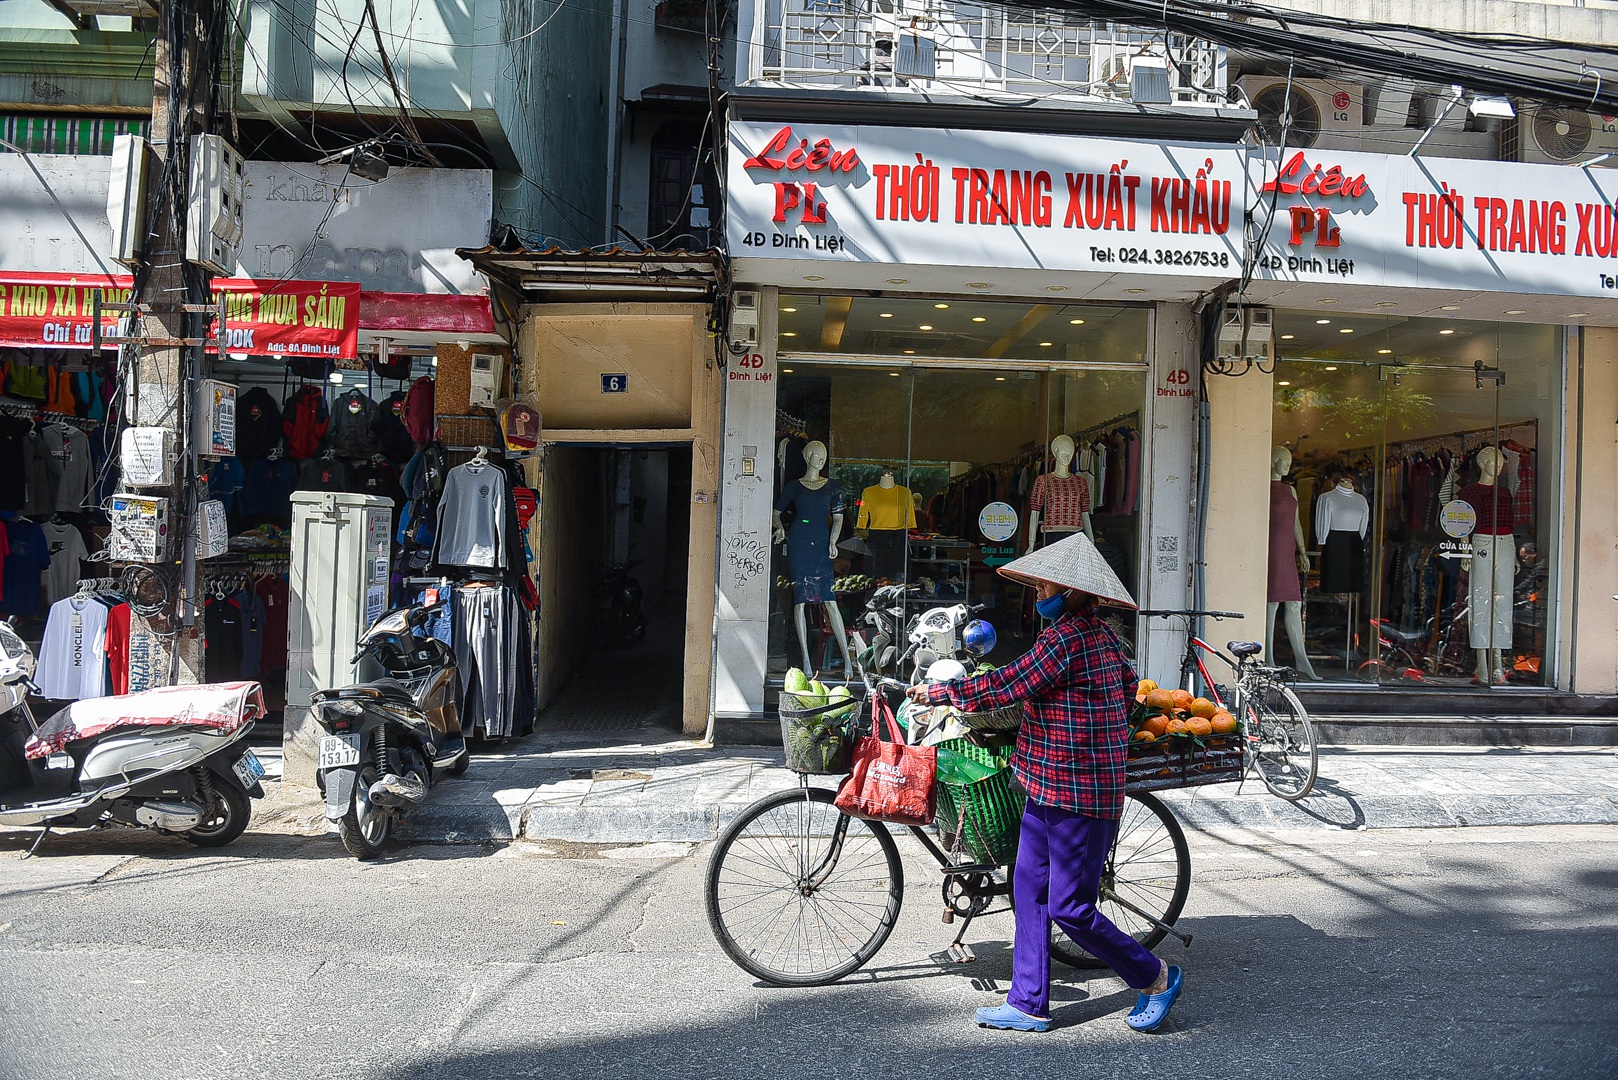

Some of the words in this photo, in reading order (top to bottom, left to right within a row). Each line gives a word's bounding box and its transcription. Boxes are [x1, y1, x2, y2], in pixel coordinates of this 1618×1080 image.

[1334, 112, 1348, 121] LG
[1602, 124, 1616, 132] LG
[743, 126, 861, 172] Liên
[1258, 151, 1369, 198] Liên
[772, 182, 828, 223] PL
[873, 153, 940, 223] THỜI
[952, 167, 1053, 228] TRANG
[1064, 160, 1141, 231] XUẤT
[1151, 158, 1231, 235] KHẨU
[1288, 206, 1341, 247] PL
[1402, 182, 1464, 249] THỜI
[1474, 197, 1567, 256] TRANG
[743, 232, 766, 247] 4Đ
[772, 233, 809, 249] Đinh
[816, 235, 845, 254] Liệt
[1090, 247, 1115, 262] Tel:
[1119, 247, 1229, 268] 024.38267538
[1260, 256, 1283, 270] 4Đ
[1288, 256, 1323, 273] Đinh
[1328, 258, 1356, 277] Liệt
[11, 286, 48, 317] KHO
[52, 278, 77, 317] XẢ
[257, 293, 298, 326] MUA
[303, 283, 346, 330] SẮM
[43, 321, 72, 343] Chỉ
[75, 323, 93, 343] từ
[267, 342, 287, 353] Add:
[288, 343, 300, 353] 8A
[302, 343, 321, 354] Đinh
[323, 344, 341, 356] Liệt
[740, 354, 764, 368] 4Đ
[610, 377, 619, 390] 6
[729, 371, 751, 381] Đinh
[755, 372, 772, 383] Liệt
[1167, 369, 1190, 385] 4Đ
[1157, 388, 1177, 397] Đinh
[325, 737, 354, 752] 89-E1
[322, 750, 357, 765] 153.17
